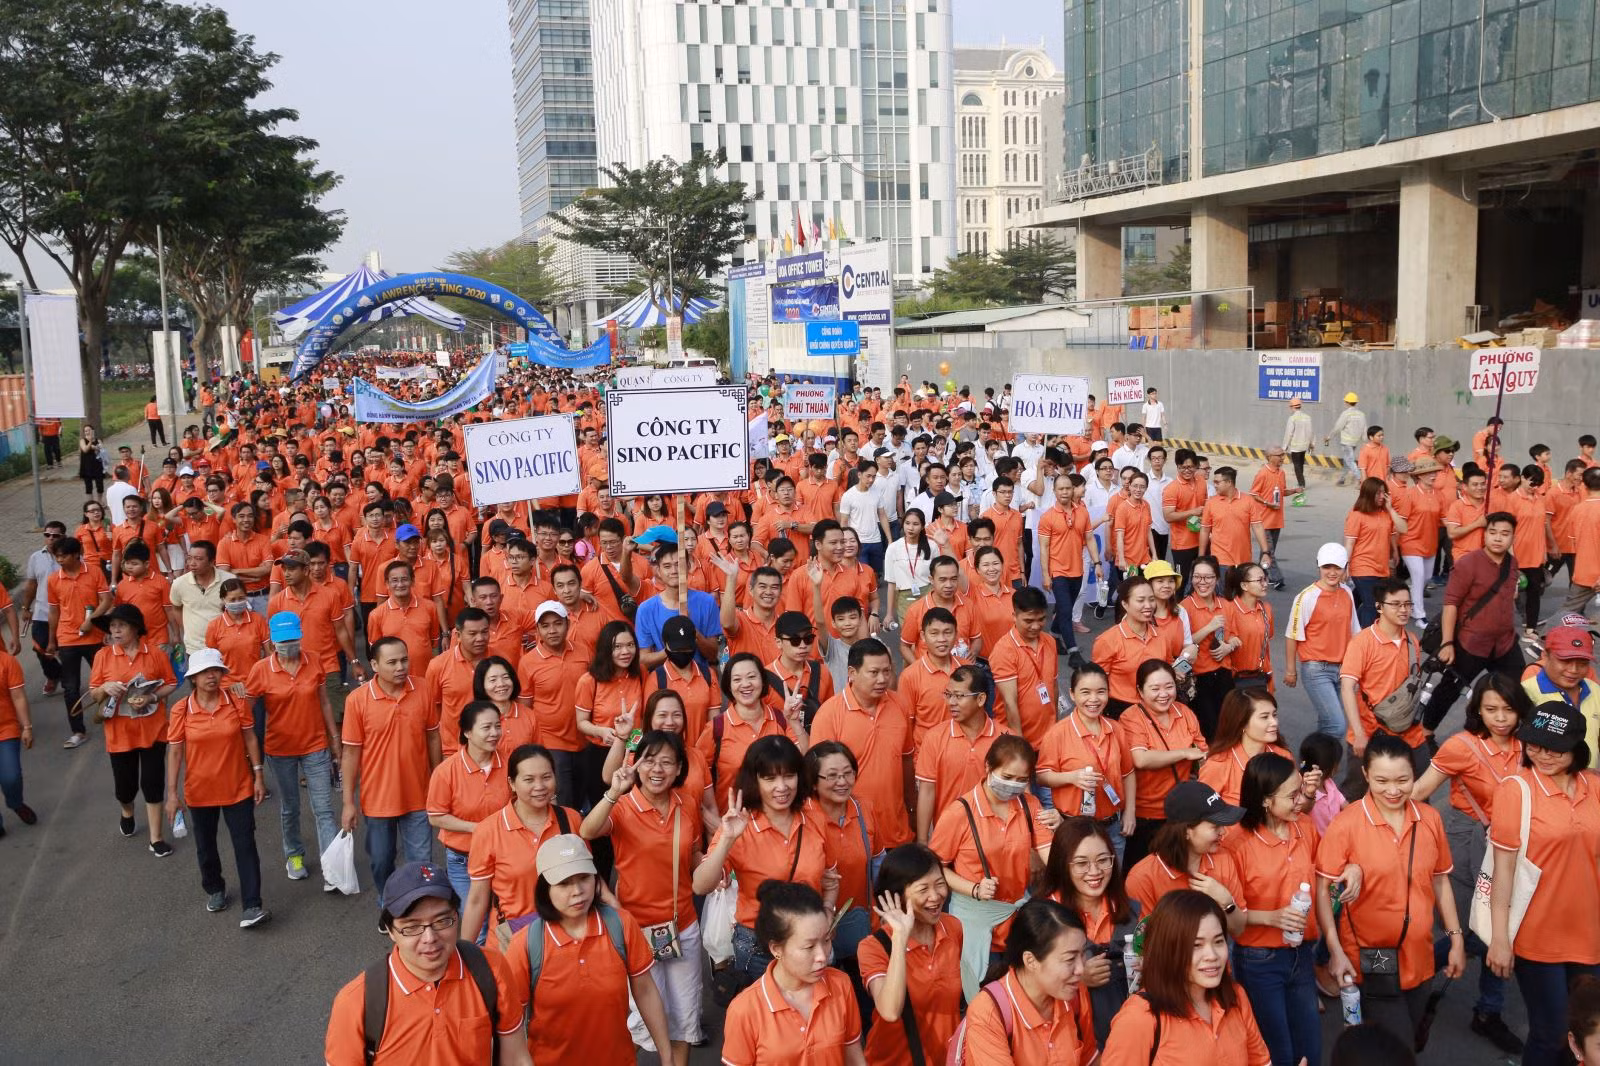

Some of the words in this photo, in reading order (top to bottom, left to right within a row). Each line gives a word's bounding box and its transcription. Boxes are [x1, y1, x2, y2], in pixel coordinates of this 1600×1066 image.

[788, 261, 804, 277] OFFICE
[804, 258, 823, 274] TOWER
[855, 269, 889, 288] CENTRAL
[440, 283, 463, 295] TING
[464, 287, 487, 300] 2020
[663, 374, 690, 383] CÔNG
[692, 374, 704, 382] TY
[1028, 381, 1058, 393] CÔNG
[1061, 384, 1075, 393] TY
[1472, 368, 1501, 389] TÂN
[1109, 390, 1122, 402] TÂN
[789, 400, 803, 413] PHÚ
[806, 400, 830, 415] THUẬN
[1049, 398, 1084, 419] BÌNH
[636, 416, 692, 437] CÔNG
[696, 418, 721, 435] TY
[488, 430, 531, 447] CÔNG
[534, 427, 553, 441] TY
[617, 446, 662, 463] SINO
[667, 442, 741, 461] PACIFIC
[475, 458, 512, 485] SINO
[514, 450, 574, 479] PACIFIC
[1550, 714, 1569, 724] Show
